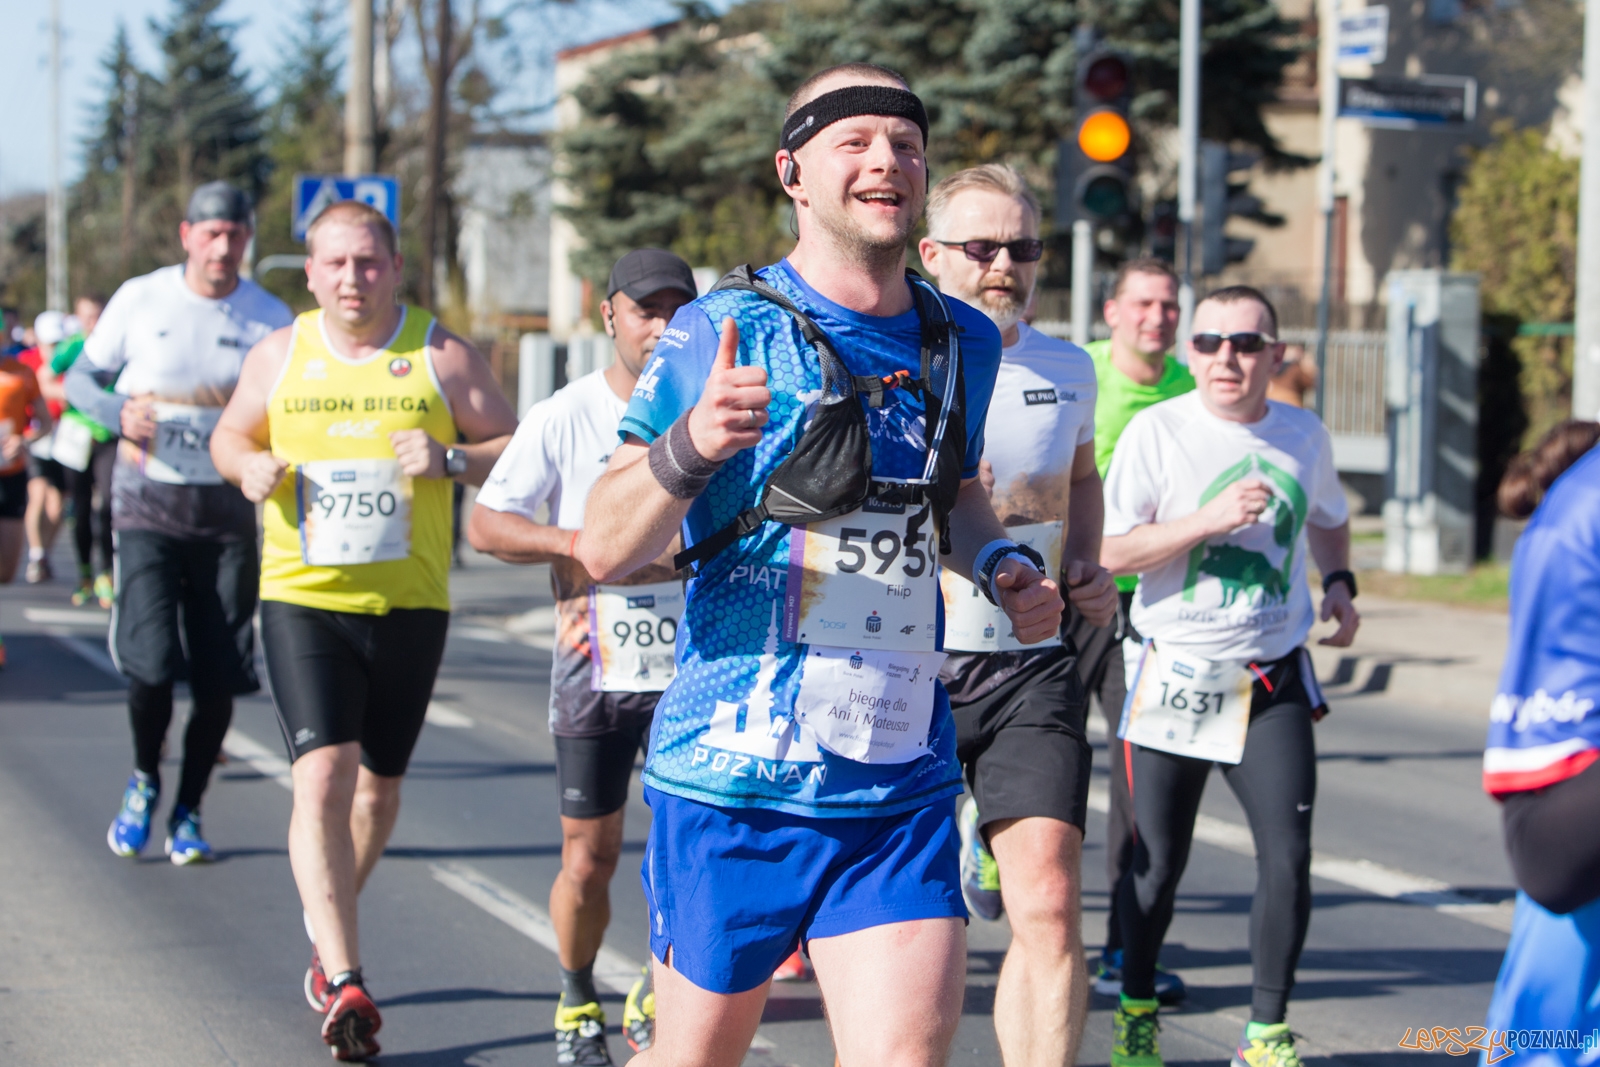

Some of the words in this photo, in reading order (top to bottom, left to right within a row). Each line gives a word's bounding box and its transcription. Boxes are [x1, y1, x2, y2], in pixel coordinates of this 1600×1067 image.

[284, 395, 353, 413] LUBOŃ
[364, 397, 428, 413] BIEGA
[319, 491, 396, 519] 9750
[886, 584, 911, 600] Filip
[900, 625, 916, 635] 4F
[848, 688, 891, 713] biegnę
[893, 698, 907, 712] dla
[1161, 682, 1225, 715] 1631
[827, 705, 852, 721] Ani
[854, 711, 860, 723] i
[863, 713, 909, 732] Mateusza
